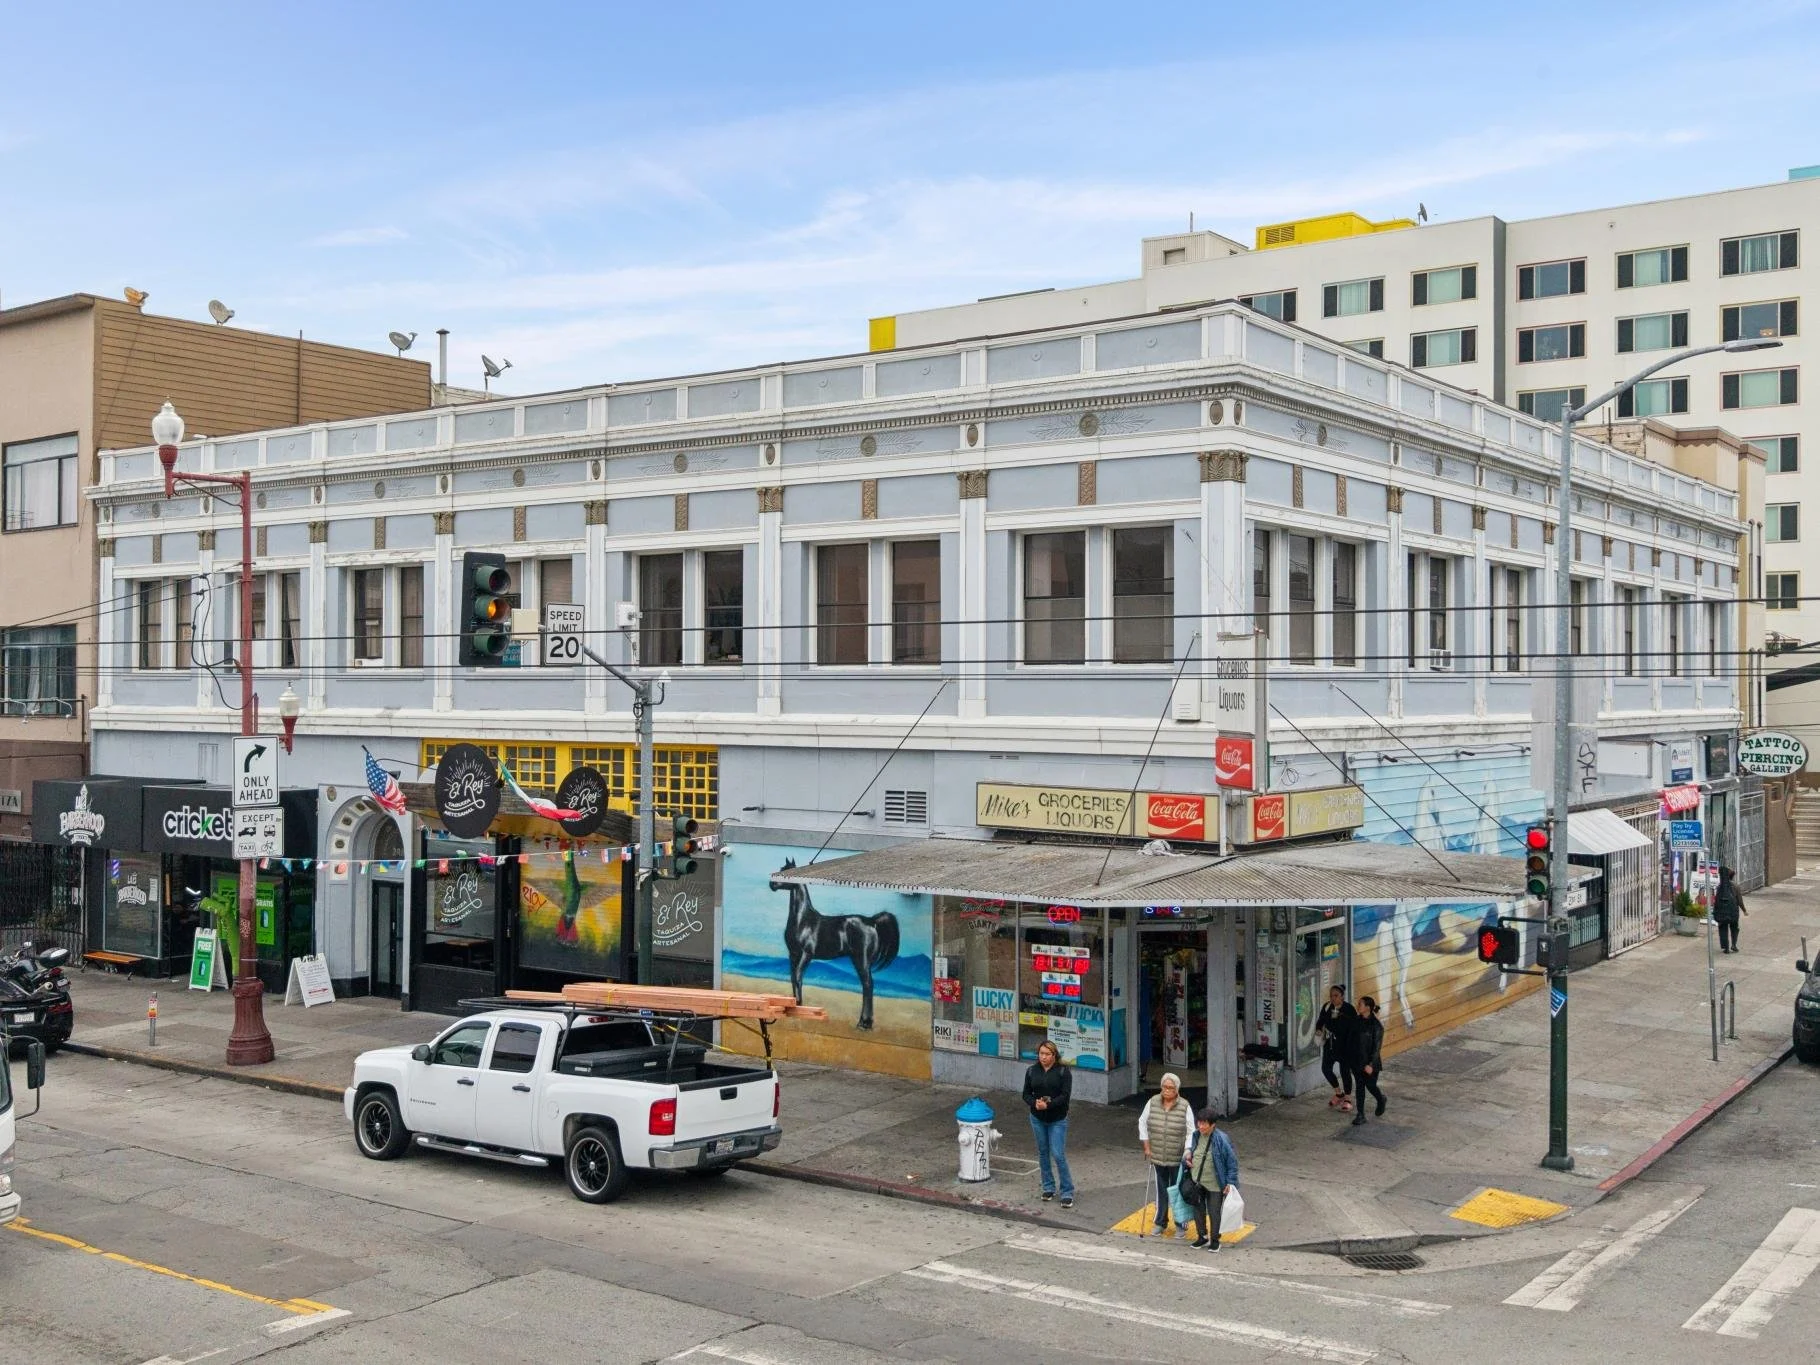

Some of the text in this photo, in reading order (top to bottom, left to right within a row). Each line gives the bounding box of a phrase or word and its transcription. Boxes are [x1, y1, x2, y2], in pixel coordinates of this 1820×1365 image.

[550, 611, 582, 621] SPEED
[552, 623, 578, 632] LIMIT
[550, 635, 580, 659] 20
[1218, 686, 1245, 712] Liquors
[1745, 737, 1800, 752] TATTOO
[1740, 752, 1803, 766] PIERCING
[1750, 764, 1792, 774] GALLERY
[243, 776, 270, 788] ONLY
[449, 773, 484, 800] El Rey
[239, 789, 273, 801] AHEAD
[580, 787, 597, 806] Rey
[981, 794, 1031, 819] Mike's
[1038, 792, 1126, 814] GROCERIES
[163, 806, 233, 840] cricket
[242, 814, 274, 823] EXCEPT
[1046, 811, 1114, 830] LIQUORS
[443, 873, 478, 905] El Rey
[657, 892, 698, 925] El Rey
[1048, 906, 1080, 921] OPEN
[656, 922, 685, 935] TAQUIZA
[652, 931, 691, 946] ARTESANAL
[975, 989, 1014, 1010] LUCKY
[976, 1010, 1014, 1023] RETAILER
[935, 1026, 951, 1037] RIKI
